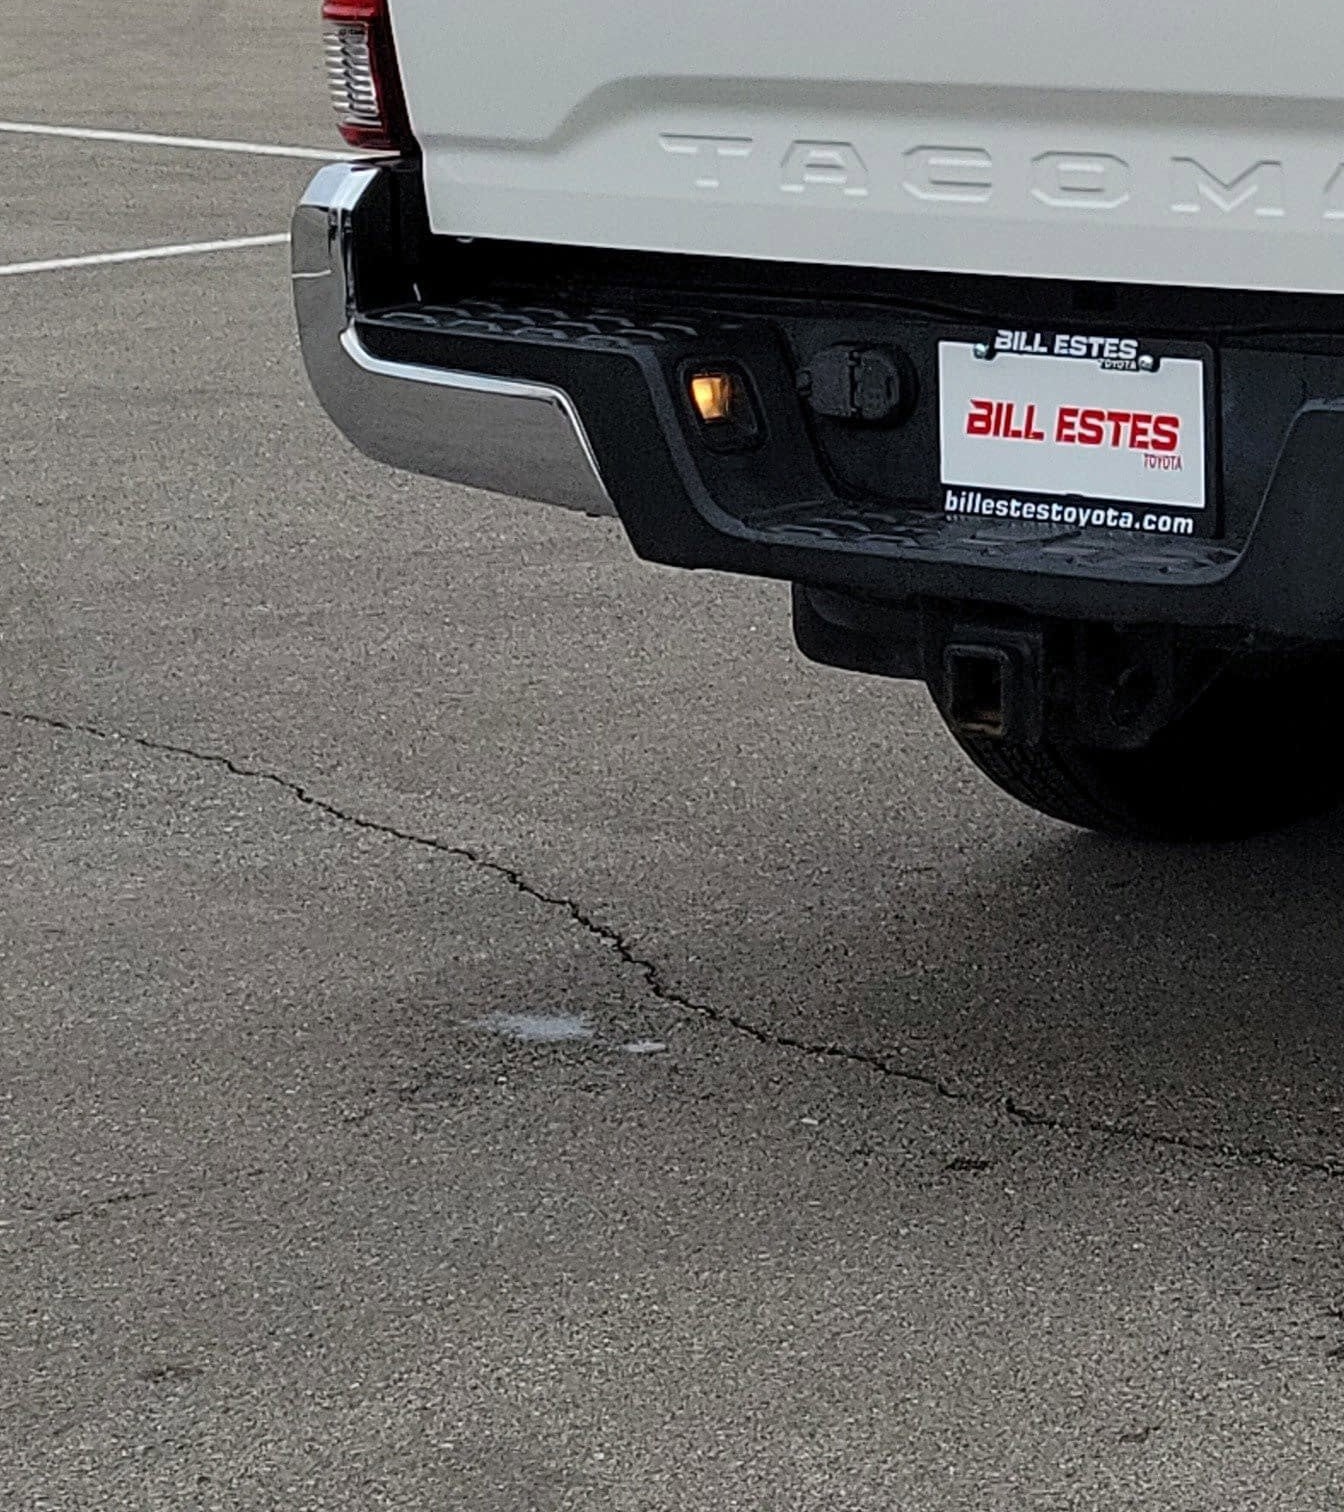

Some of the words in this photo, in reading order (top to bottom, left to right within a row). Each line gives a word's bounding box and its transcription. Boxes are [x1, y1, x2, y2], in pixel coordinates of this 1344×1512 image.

[995, 329, 1048, 354] BILL
[1054, 334, 1138, 360] ESTES
[1099, 358, 1137, 371] TOYOTA
[966, 399, 1045, 441] BILL
[1055, 407, 1181, 452] ESTES
[1143, 453, 1183, 471] TOYOTA
[944, 490, 1195, 535] billestestoyota.com
